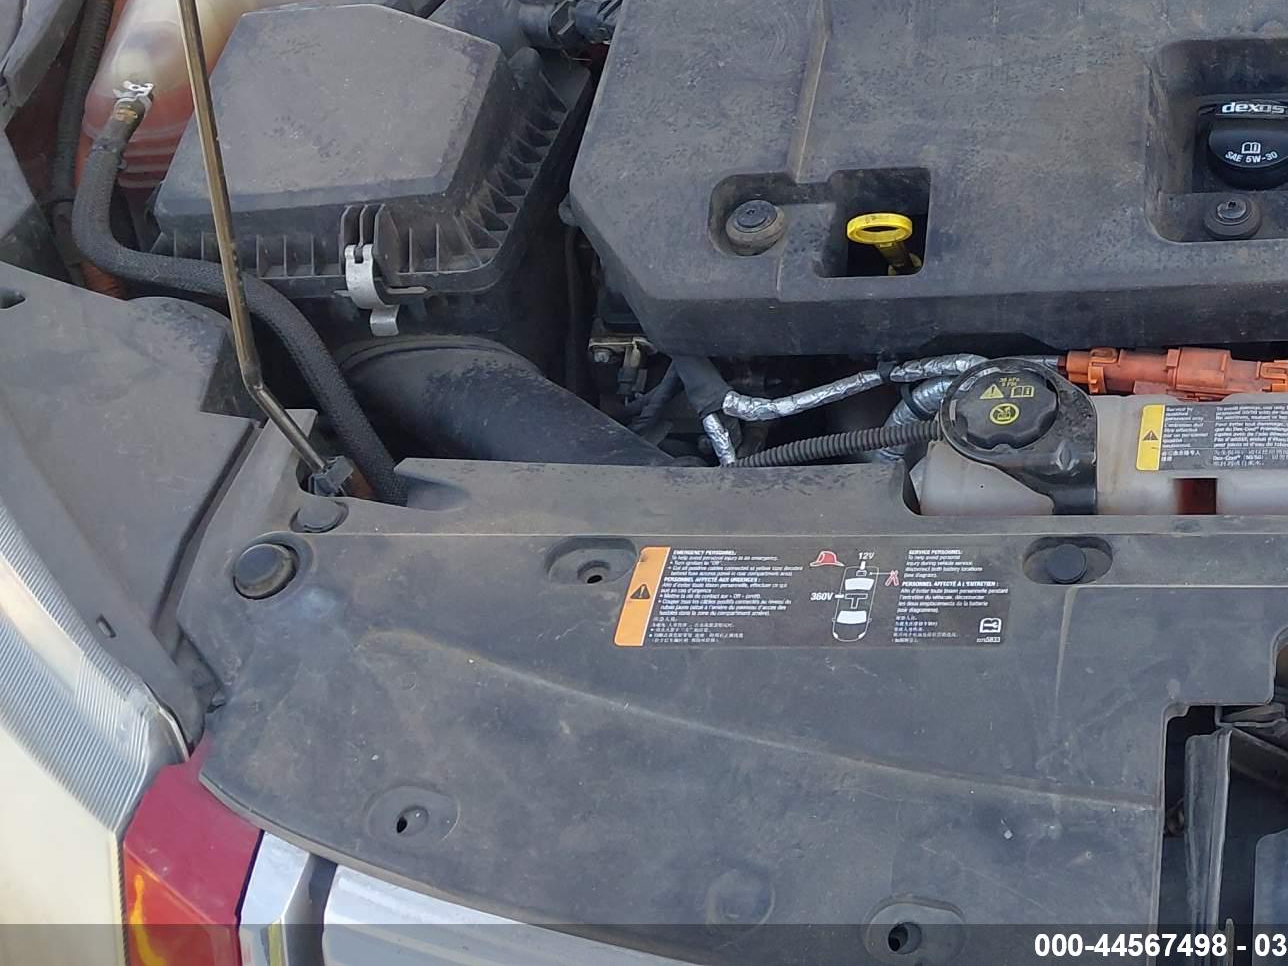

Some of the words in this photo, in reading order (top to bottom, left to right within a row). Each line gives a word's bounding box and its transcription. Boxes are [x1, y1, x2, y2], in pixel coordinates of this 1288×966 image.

[1221, 102, 1288, 114] dexos
[1225, 151, 1243, 163] SAE
[1245, 151, 1278, 163] 5W-30
[858, 552, 875, 560] 12V
[810, 592, 834, 601] 360V
